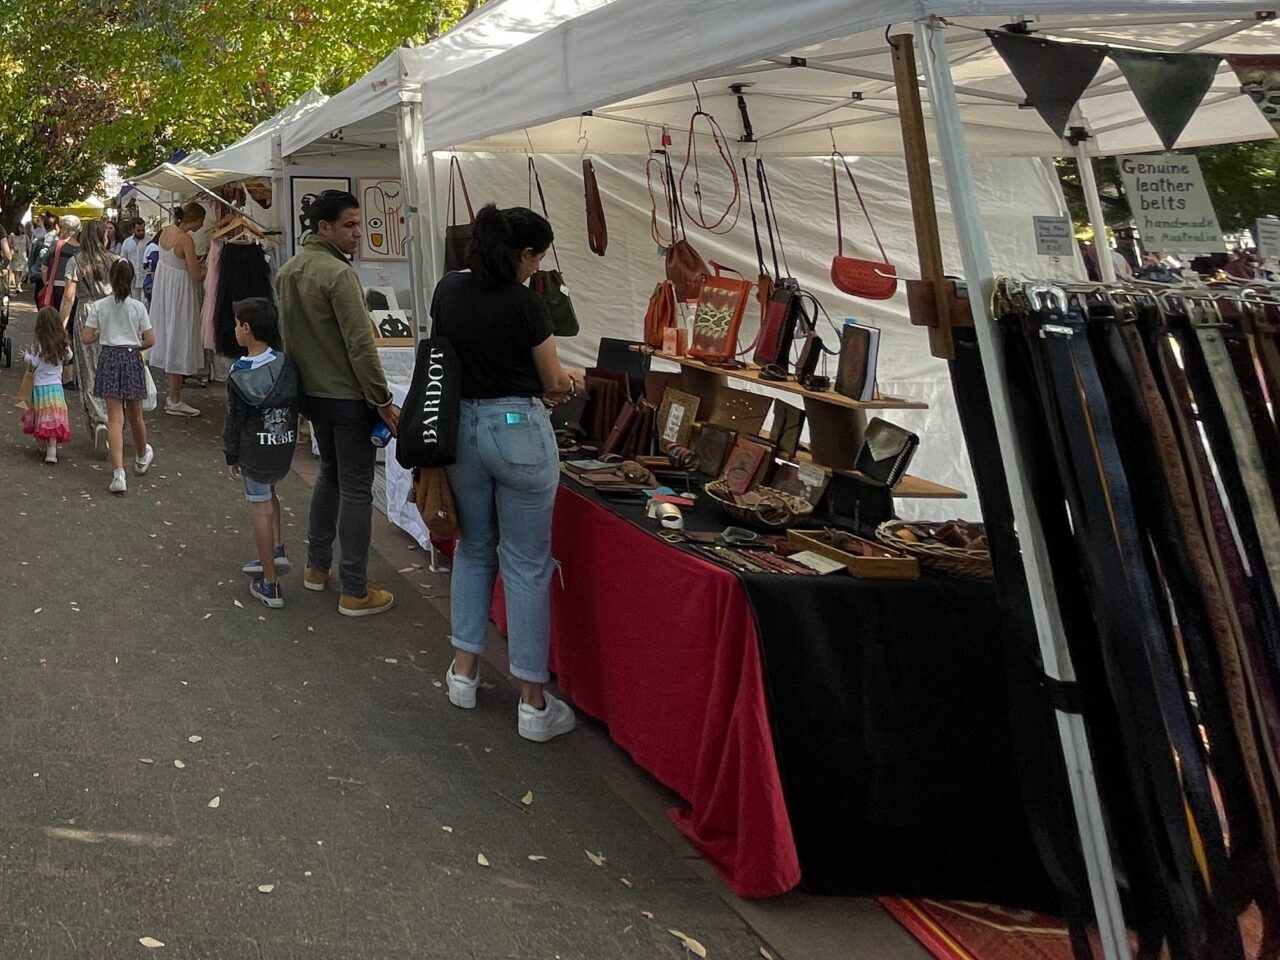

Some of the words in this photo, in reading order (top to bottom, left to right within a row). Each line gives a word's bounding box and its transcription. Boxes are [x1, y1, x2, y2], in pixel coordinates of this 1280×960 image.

[1121, 159, 1190, 175] Genuine
[1136, 178, 1194, 193] leather
[1140, 195, 1186, 211] belts
[1144, 215, 1216, 229] handmade
[422, 347, 444, 446] BARDOT
